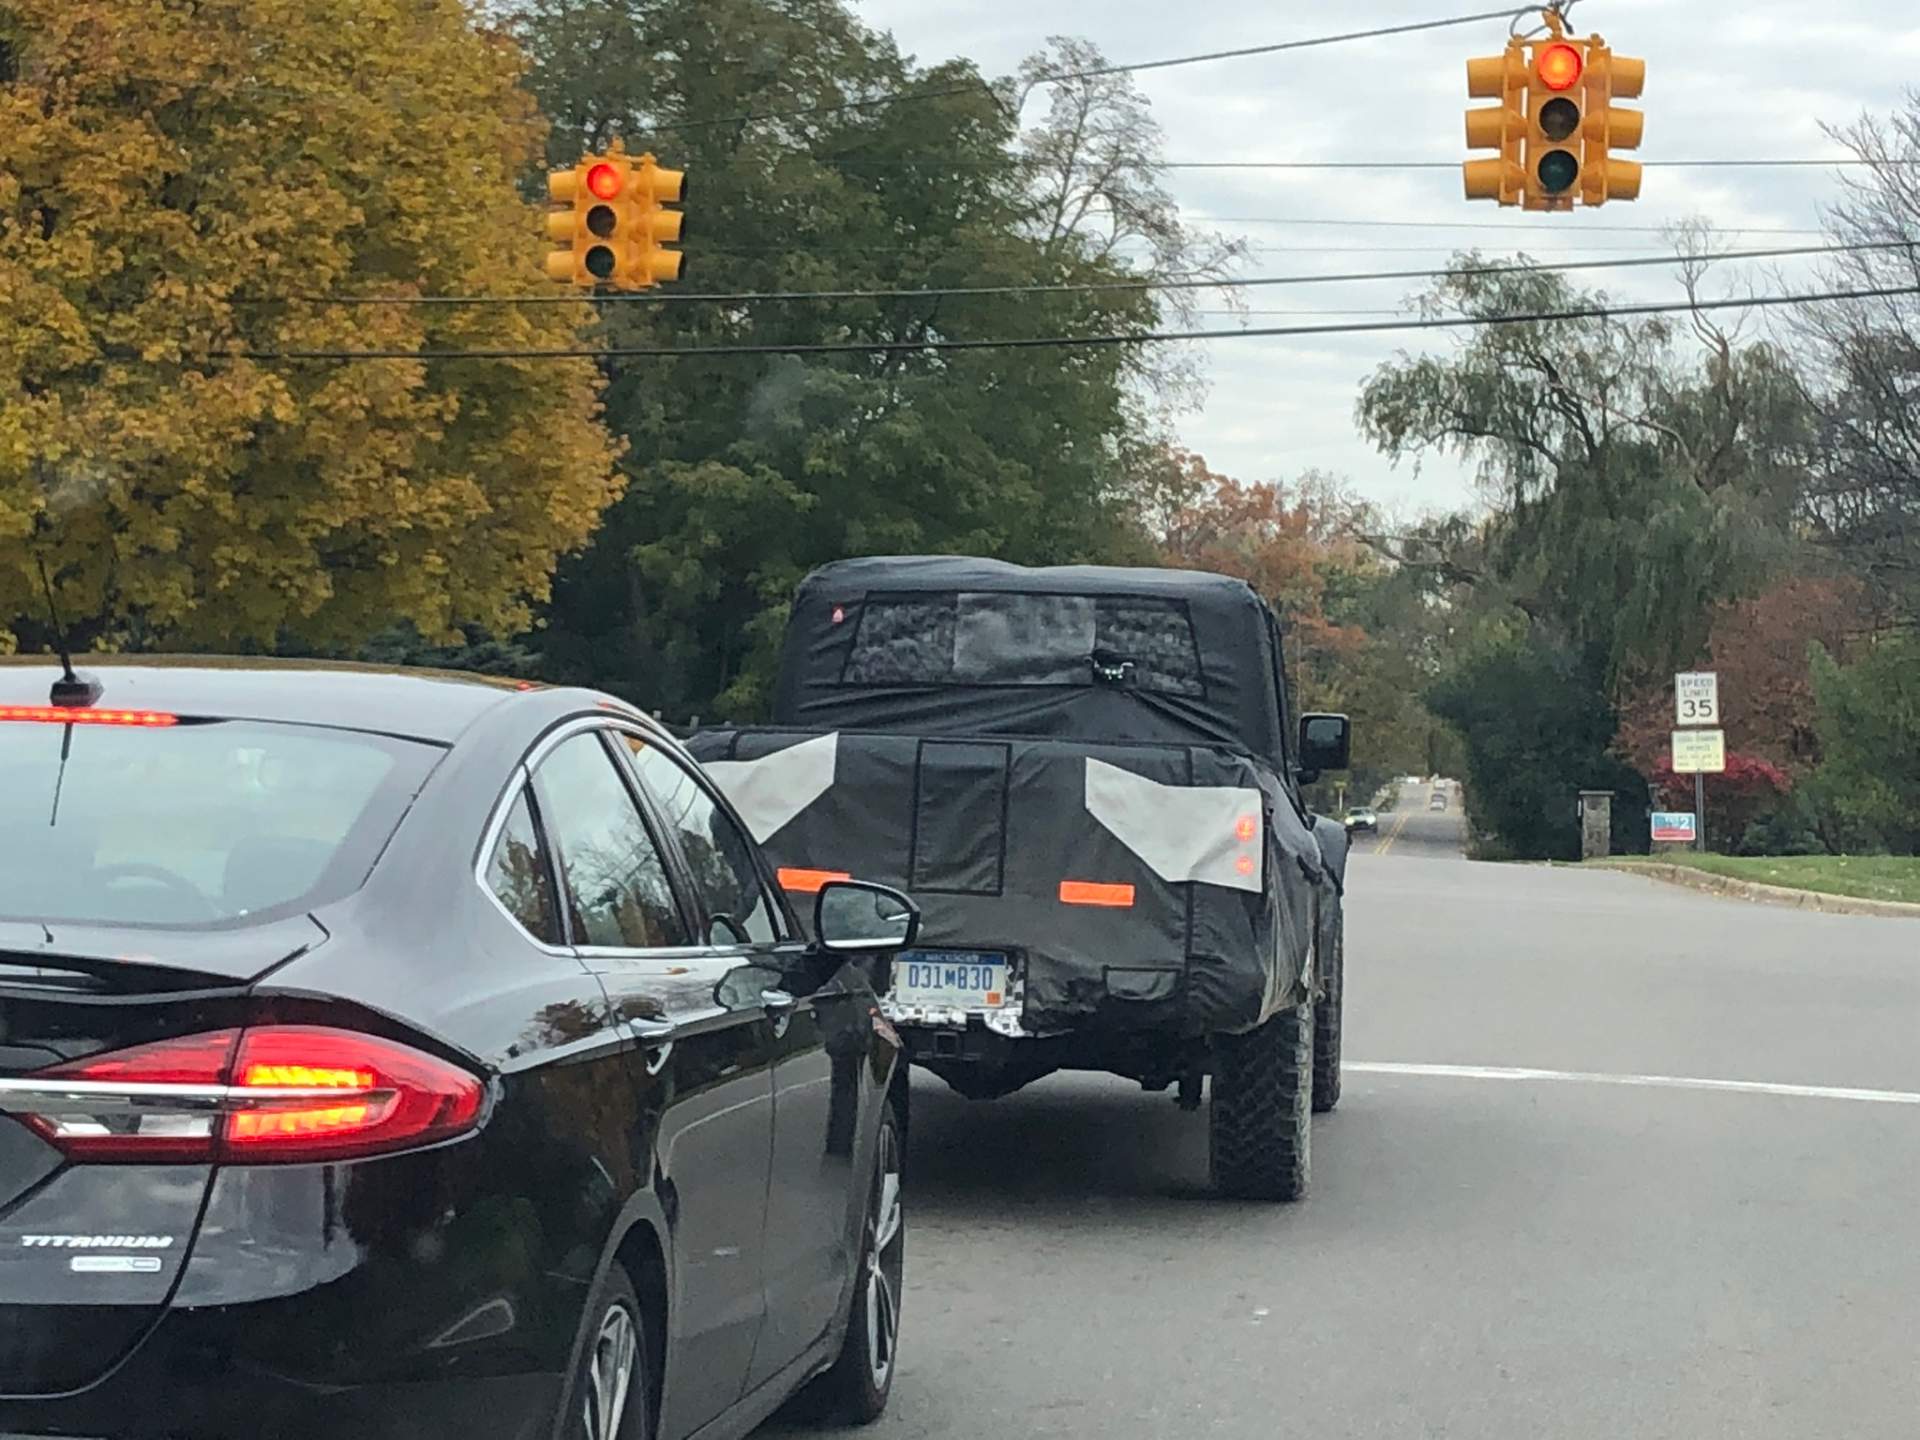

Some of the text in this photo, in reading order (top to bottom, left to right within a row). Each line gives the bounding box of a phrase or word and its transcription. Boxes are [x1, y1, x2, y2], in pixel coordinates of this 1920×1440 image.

[1680, 678, 1713, 687] SPEED
[1683, 687, 1710, 697] LIMIT
[1682, 698, 1713, 718] 35
[21, 1235, 174, 1248] TITANIUM
